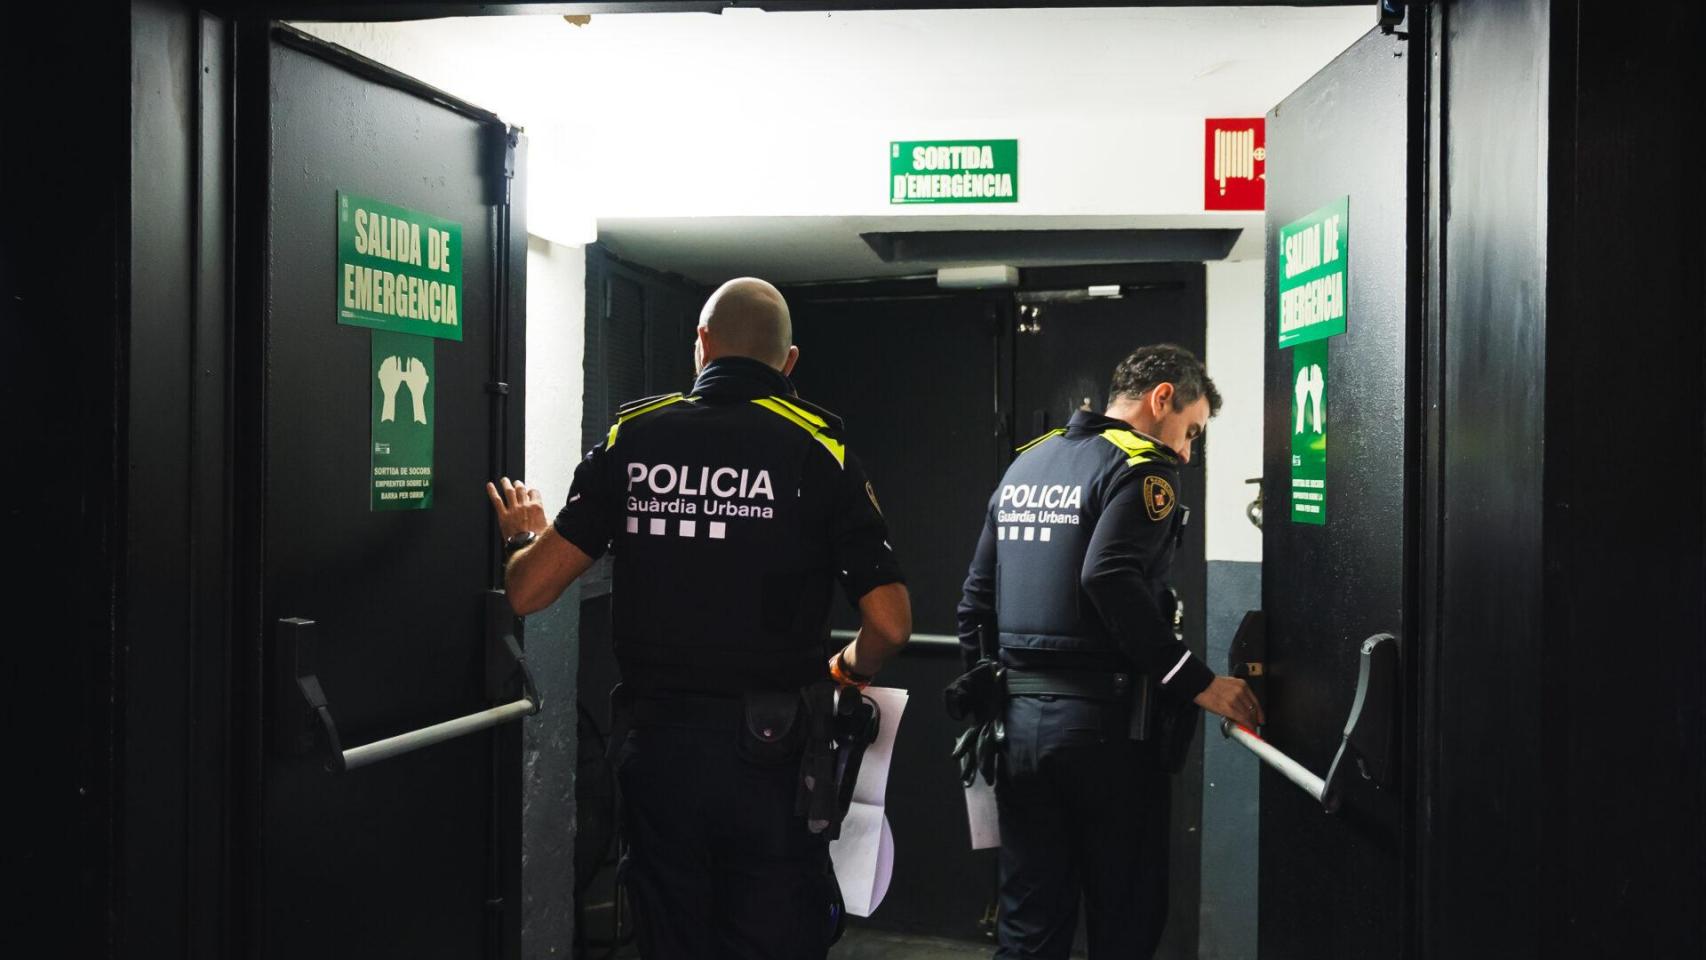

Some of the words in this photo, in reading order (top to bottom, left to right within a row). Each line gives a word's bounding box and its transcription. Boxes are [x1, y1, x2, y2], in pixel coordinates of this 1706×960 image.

[912, 145, 994, 171] SORTIDA
[355, 208, 422, 266] SALIDA
[428, 227, 450, 273] DE
[1285, 223, 1321, 279] SALIDA
[1323, 214, 1340, 264] DE
[344, 263, 458, 326] EMERGENCIA
[1281, 271, 1344, 334] EMERGENCIA
[374, 467, 399, 476] SORTIDA
[400, 467, 408, 475] DE
[627, 462, 775, 500] POLICIA
[627, 496, 697, 514] Guàrdia
[703, 500, 774, 519] Urbana
[999, 484, 1082, 509] POLICIA
[998, 509, 1036, 523] Guàrdia
[1038, 510, 1080, 525] Urbana
